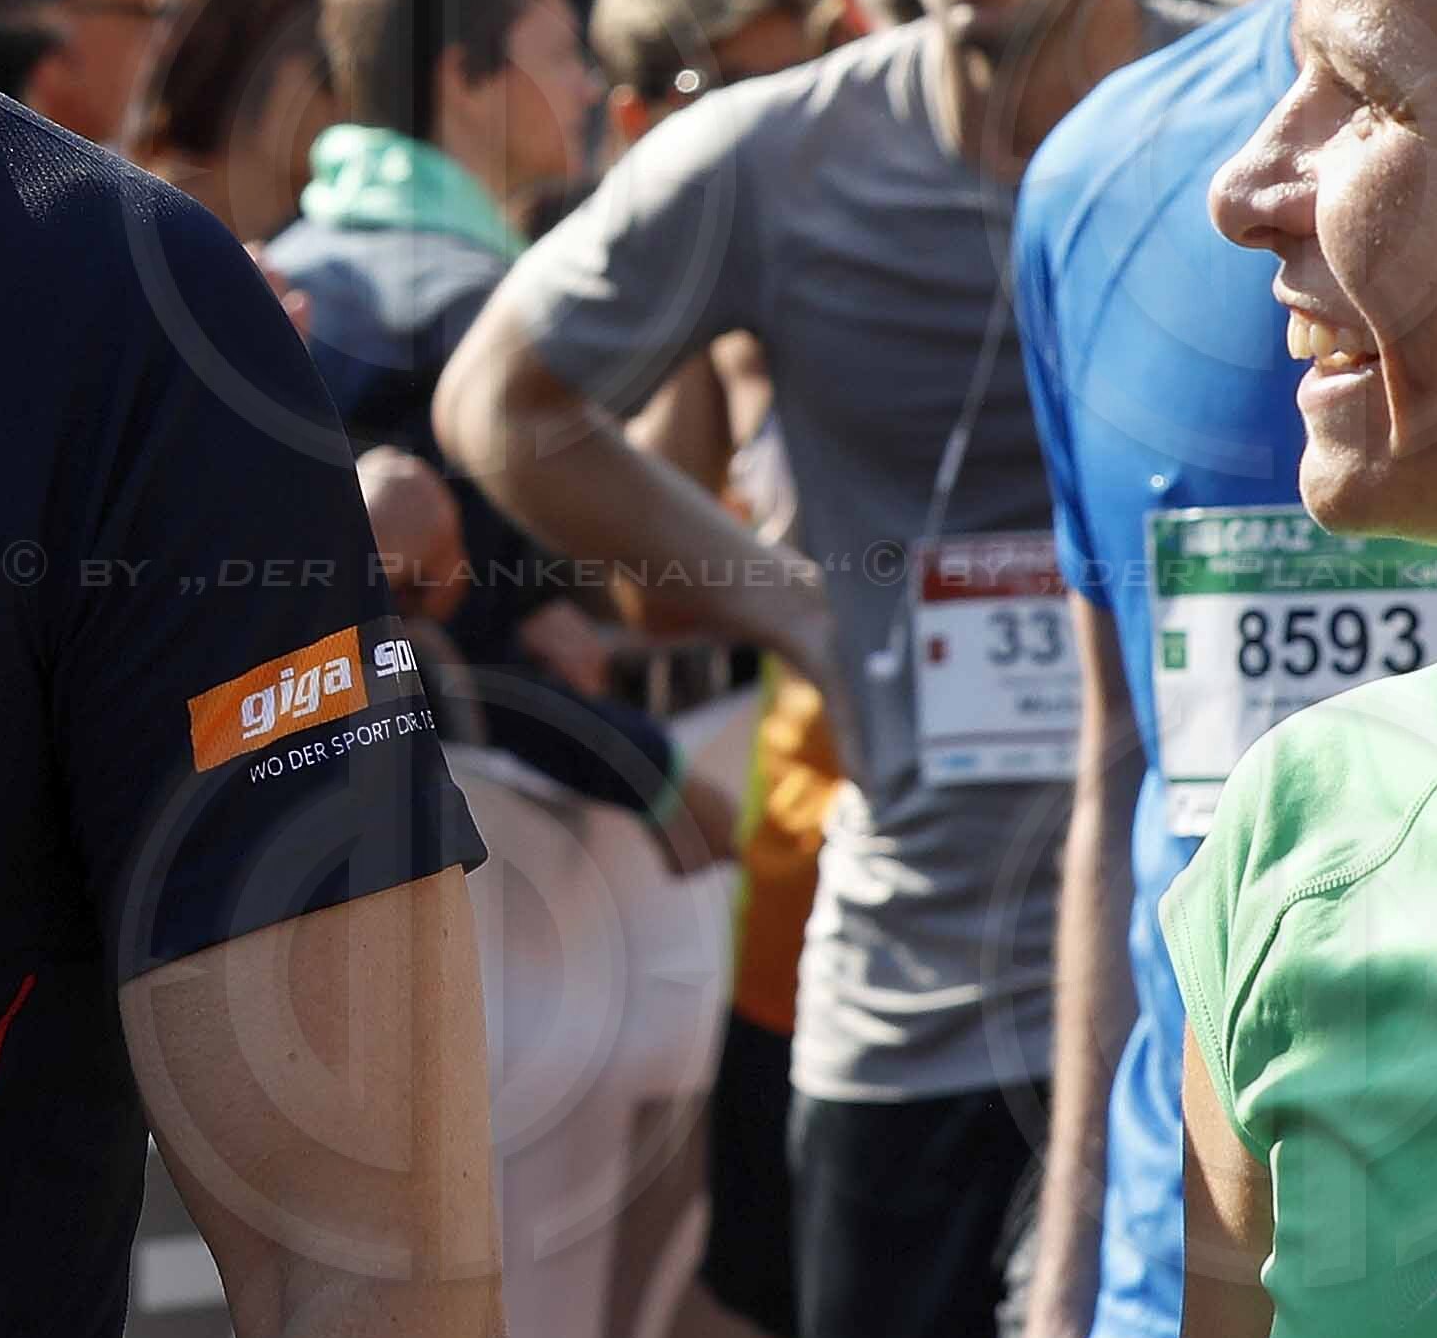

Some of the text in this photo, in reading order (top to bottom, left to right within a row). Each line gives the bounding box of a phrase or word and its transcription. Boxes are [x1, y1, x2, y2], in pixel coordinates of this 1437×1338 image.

[1237, 605, 1423, 678] 8593
[240, 656, 354, 739] giga
[249, 756, 284, 784] WO
[289, 742, 329, 770] DER
[331, 718, 391, 756] SPORT
